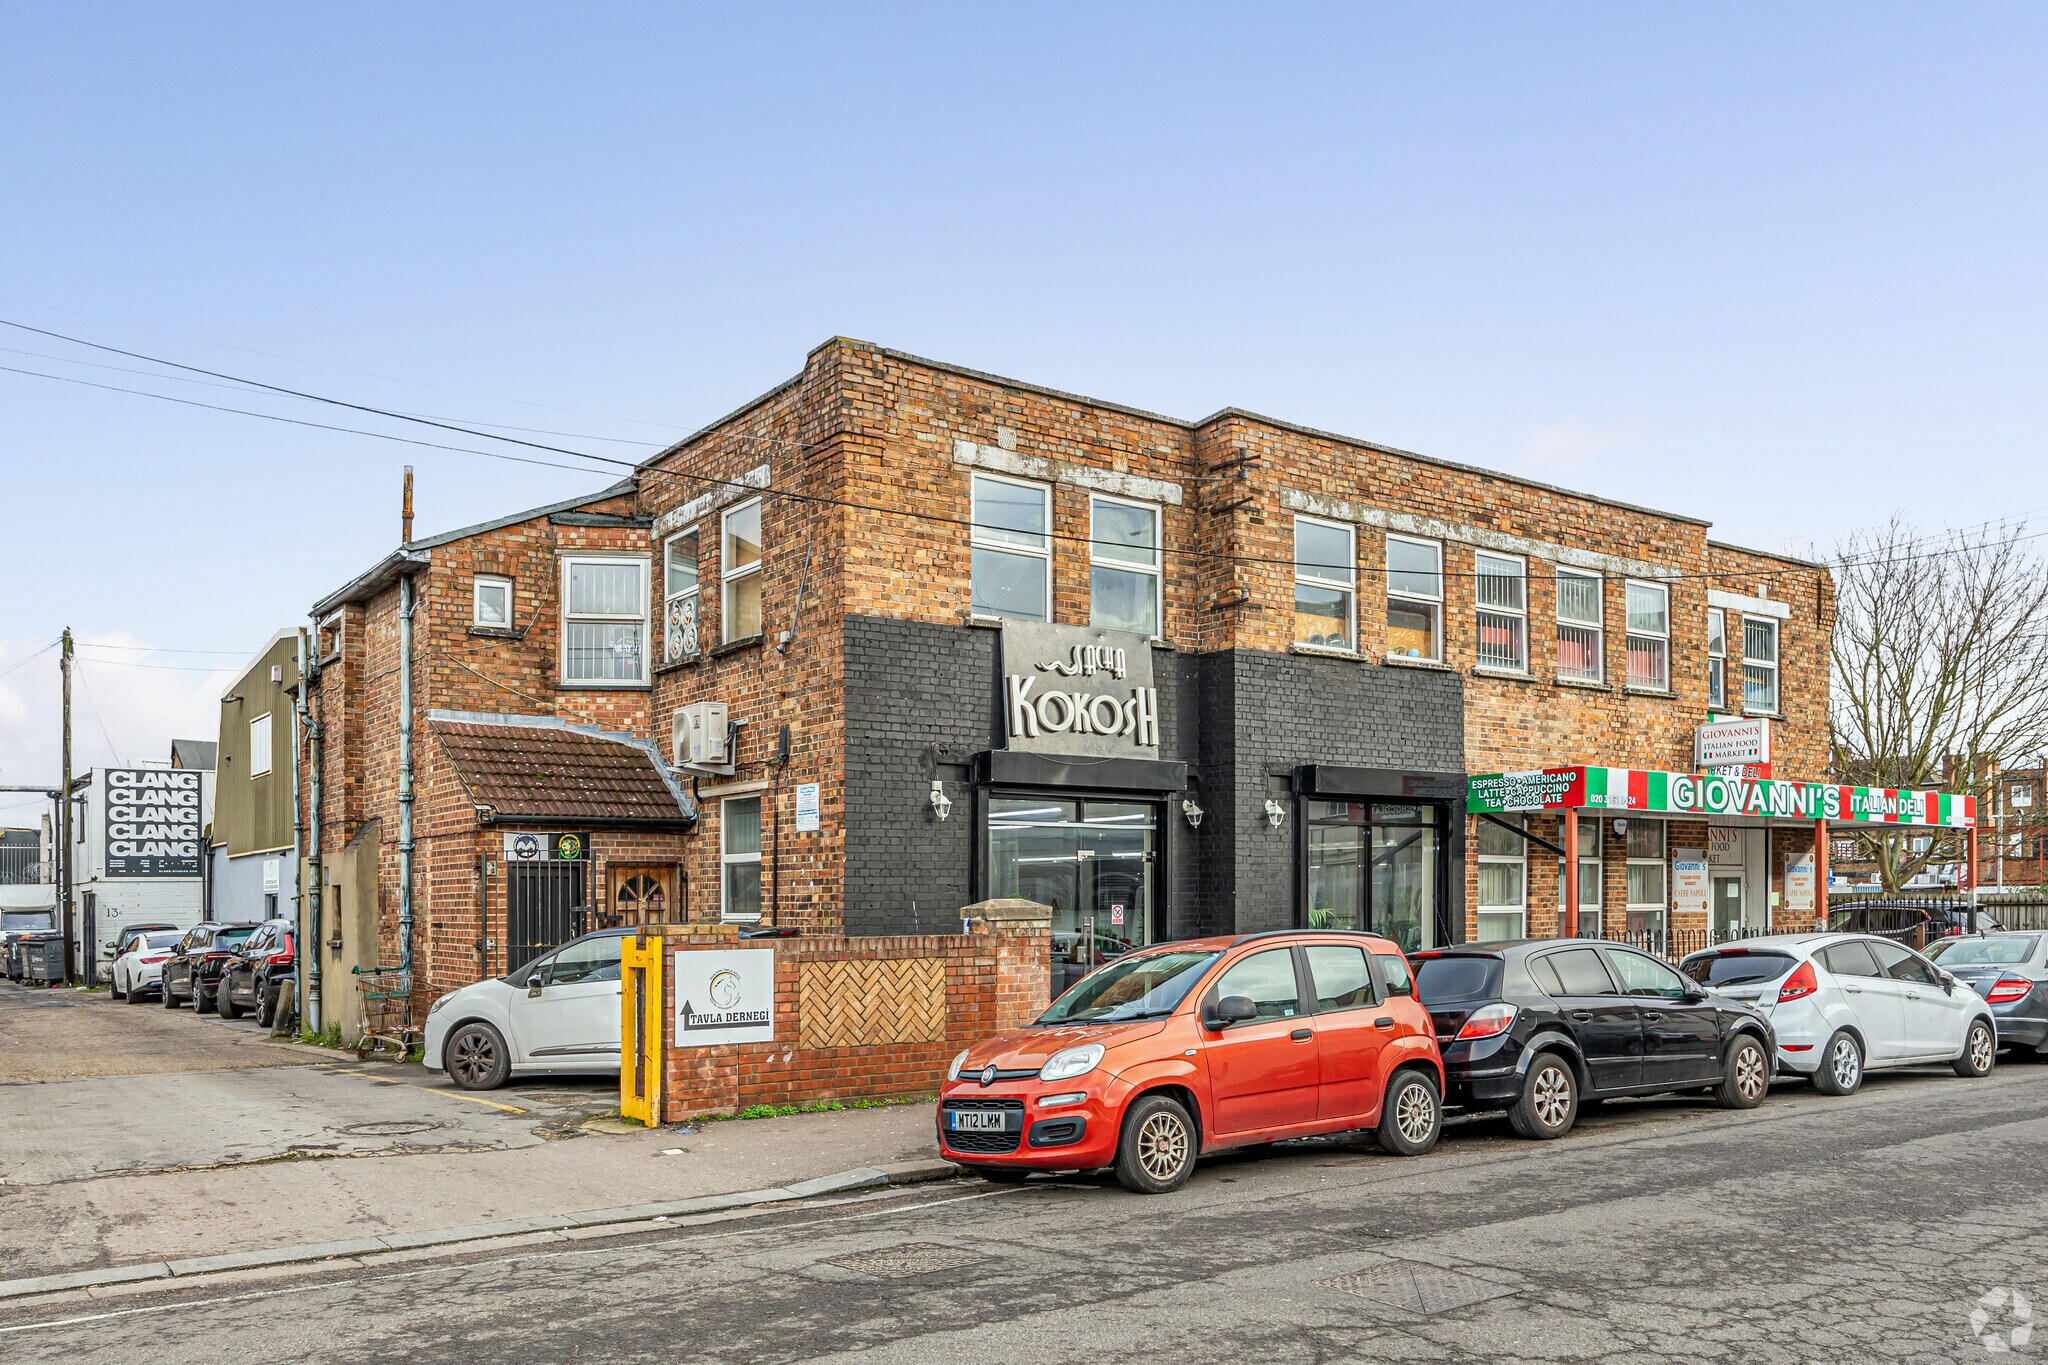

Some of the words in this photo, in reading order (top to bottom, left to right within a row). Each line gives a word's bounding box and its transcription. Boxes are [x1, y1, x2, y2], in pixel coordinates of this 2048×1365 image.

[1040, 644, 1127, 679] SACHA
[1011, 674, 1160, 746] KOKOSH
[1702, 726, 1760, 740] GIOVANNI'S
[1703, 741, 1733, 750] ITALIAN
[1735, 739, 1758, 748] FOOD
[1714, 749, 1746, 759] MARKET
[108, 770, 199, 789] CLANG
[1471, 776, 1516, 790] ESPRESSO
[1521, 771, 1577, 785] AMERICANO
[1734, 766, 1740, 777] &
[1741, 767, 1761, 778] DELI
[108, 788, 199, 806] CLANG
[1478, 786, 1508, 799] LATTE
[1510, 782, 1570, 796] CAPPUCCINO
[1590, 794, 1603, 804] 020
[1672, 776, 1841, 818] GIOVANNI'S
[1485, 798, 1502, 808] TEA
[1507, 793, 1563, 807] CHOCOLATE
[1850, 794, 1898, 815] ITALIAN
[1899, 798, 1925, 817] DELI
[108, 805, 199, 823] CLANG
[108, 823, 199, 840] CLANG
[1708, 828, 1738, 843] NNI'S
[108, 840, 199, 857] CLANG
[1711, 842, 1730, 852] FOOD
[690, 1012, 723, 1024] TAVLA
[980, 1113, 1001, 1128] LMM
